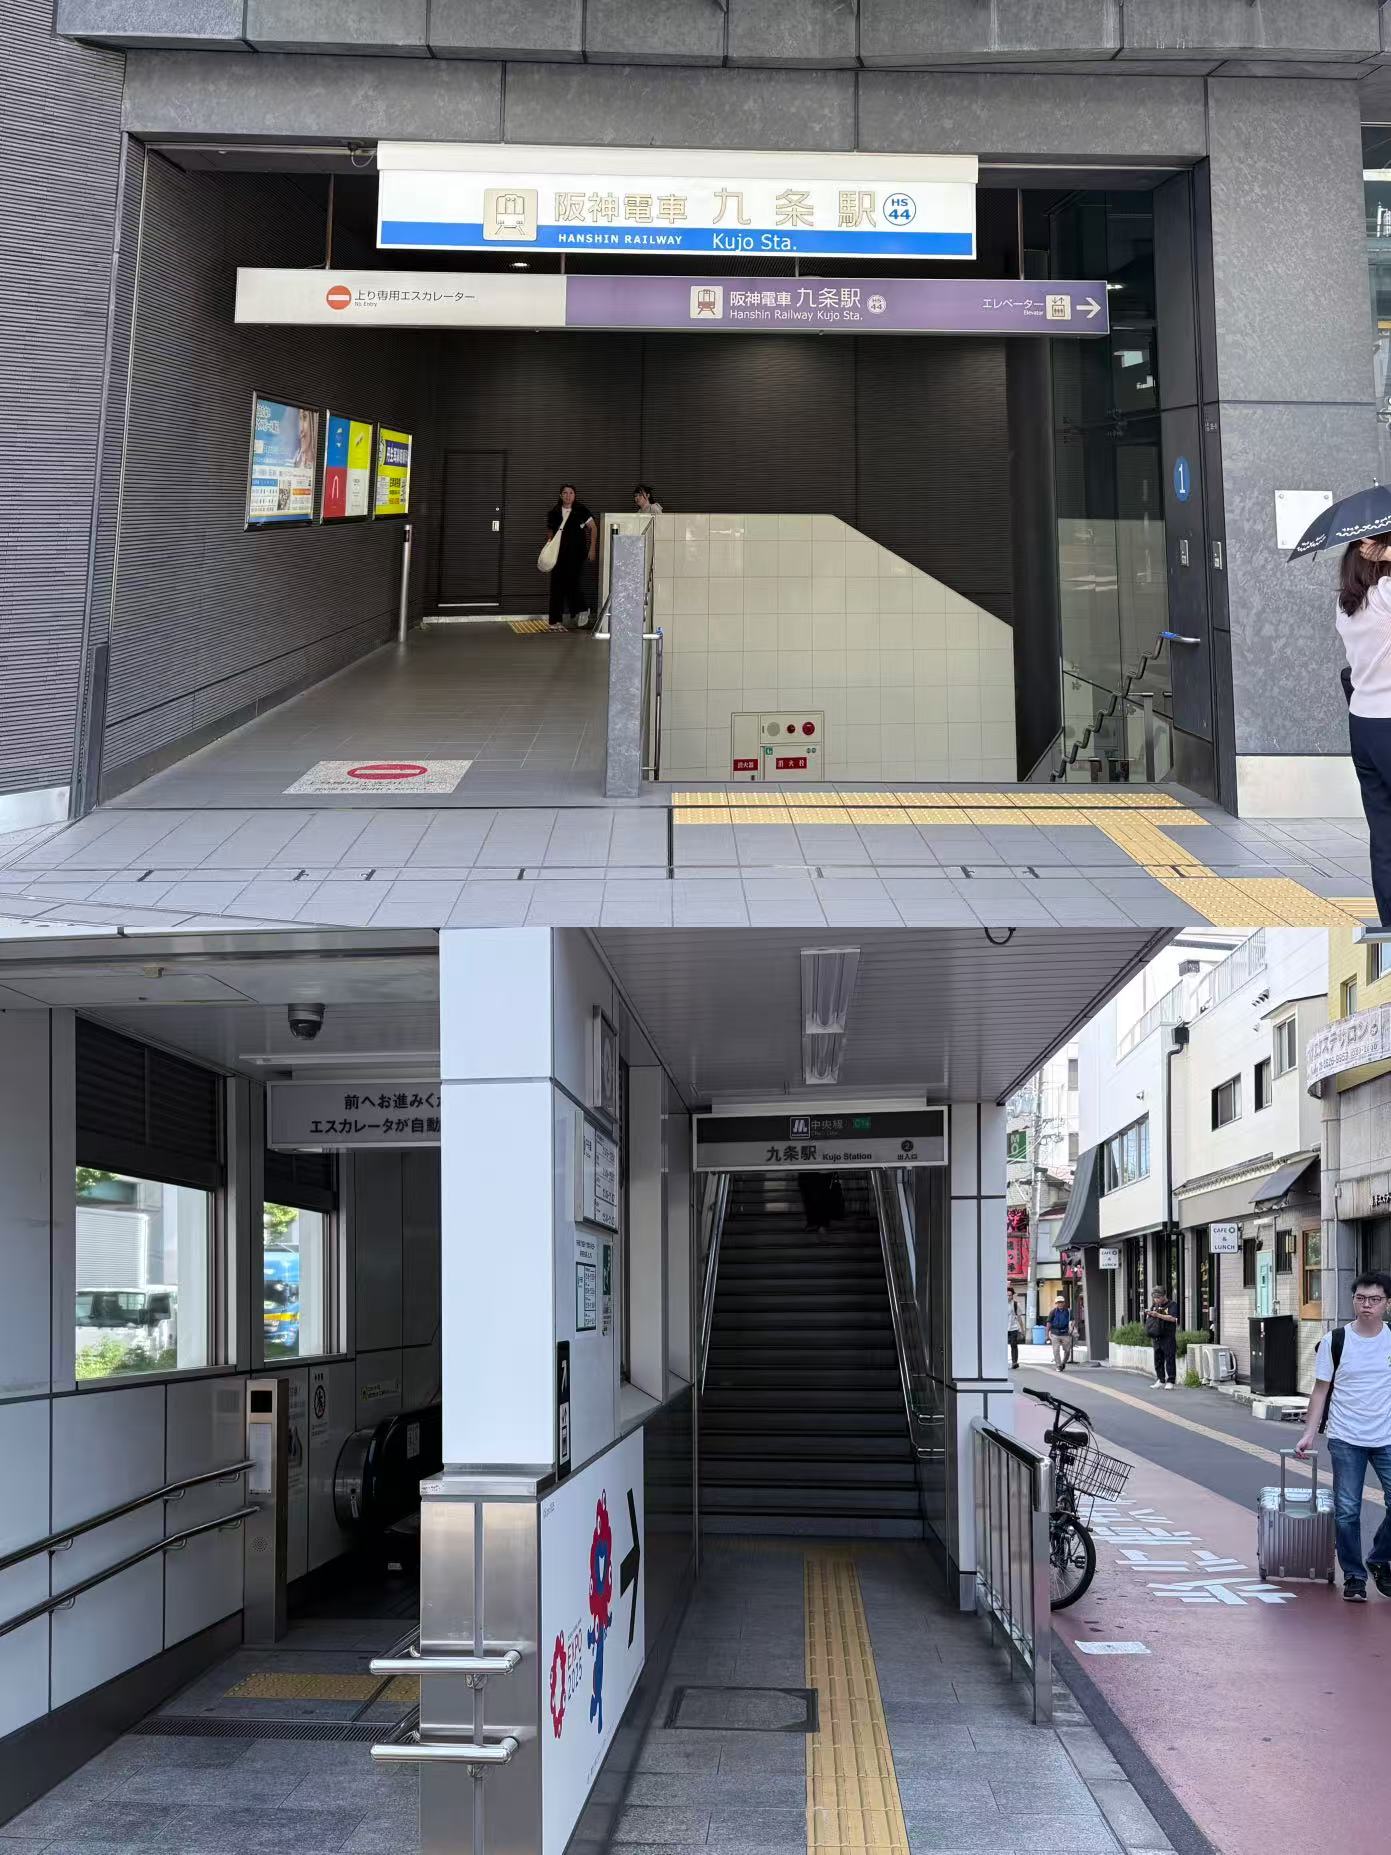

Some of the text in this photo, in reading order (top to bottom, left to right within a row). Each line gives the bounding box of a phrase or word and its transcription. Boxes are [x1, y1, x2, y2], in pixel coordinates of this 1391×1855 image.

[553, 188, 877, 229] 阪神電車 九条駅
[891, 198, 909, 208] HS
[888, 208, 912, 222] 44
[558, 232, 798, 252] HANSHIN RAILWAY Kujo Sta.
[354, 290, 475, 302] 上り専用エスカレーター
[729, 287, 861, 309] 阪神電車 九条駅
[982, 298, 1045, 310] エレベーター
[729, 309, 864, 322] Hanshin Railway Kujo Sta.
[1177, 463, 1186, 494] 1
[344, 1093, 441, 1110] 前へお進みく
[766, 1145, 817, 1163] 九条駅
[822, 1151, 872, 1162] Kujo Station
[567, 1627, 583, 1672] EXPO
[567, 1657, 583, 1702] 2025
